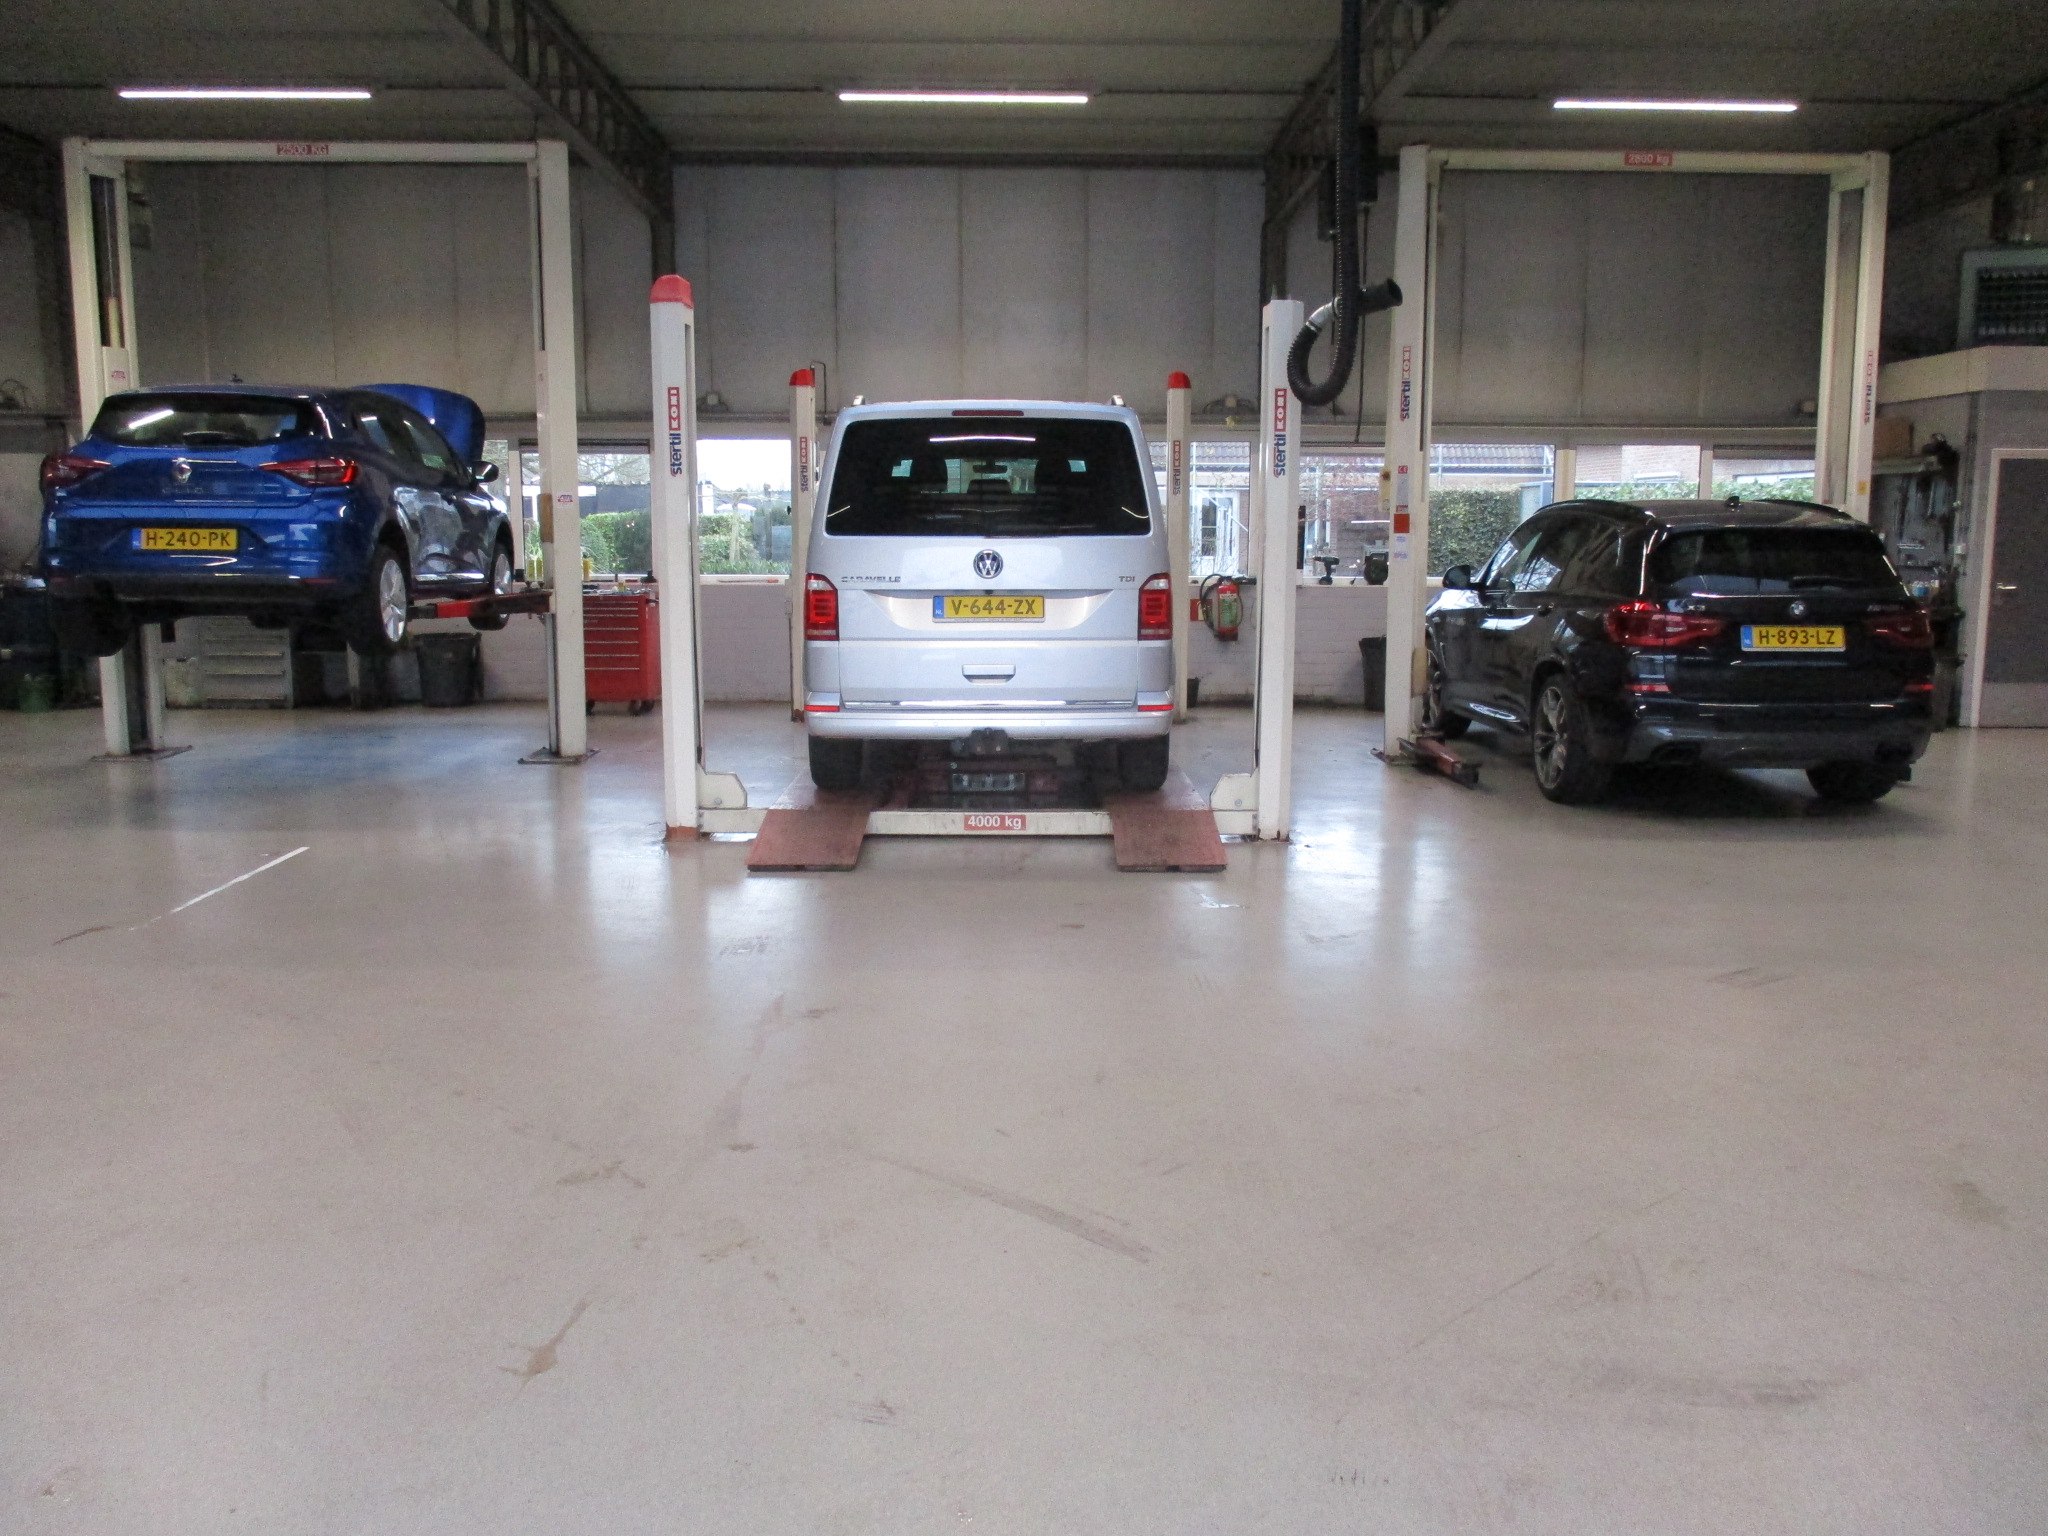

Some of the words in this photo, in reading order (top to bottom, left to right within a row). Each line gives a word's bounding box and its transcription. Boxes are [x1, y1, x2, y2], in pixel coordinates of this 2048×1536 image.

[669, 388, 680, 430] KONI
[1275, 389, 1286, 431] KONI
[1400, 381, 1411, 421] stertil
[669, 433, 682, 477] stertil
[1274, 434, 1286, 478] stertil
[146, 531, 230, 546] H-240-PK
[951, 599, 1036, 615] V-644-ZX
[1759, 629, 1836, 645] H-893-LZ
[967, 816, 1000, 828] 4000
[1005, 816, 1022, 830] kg
